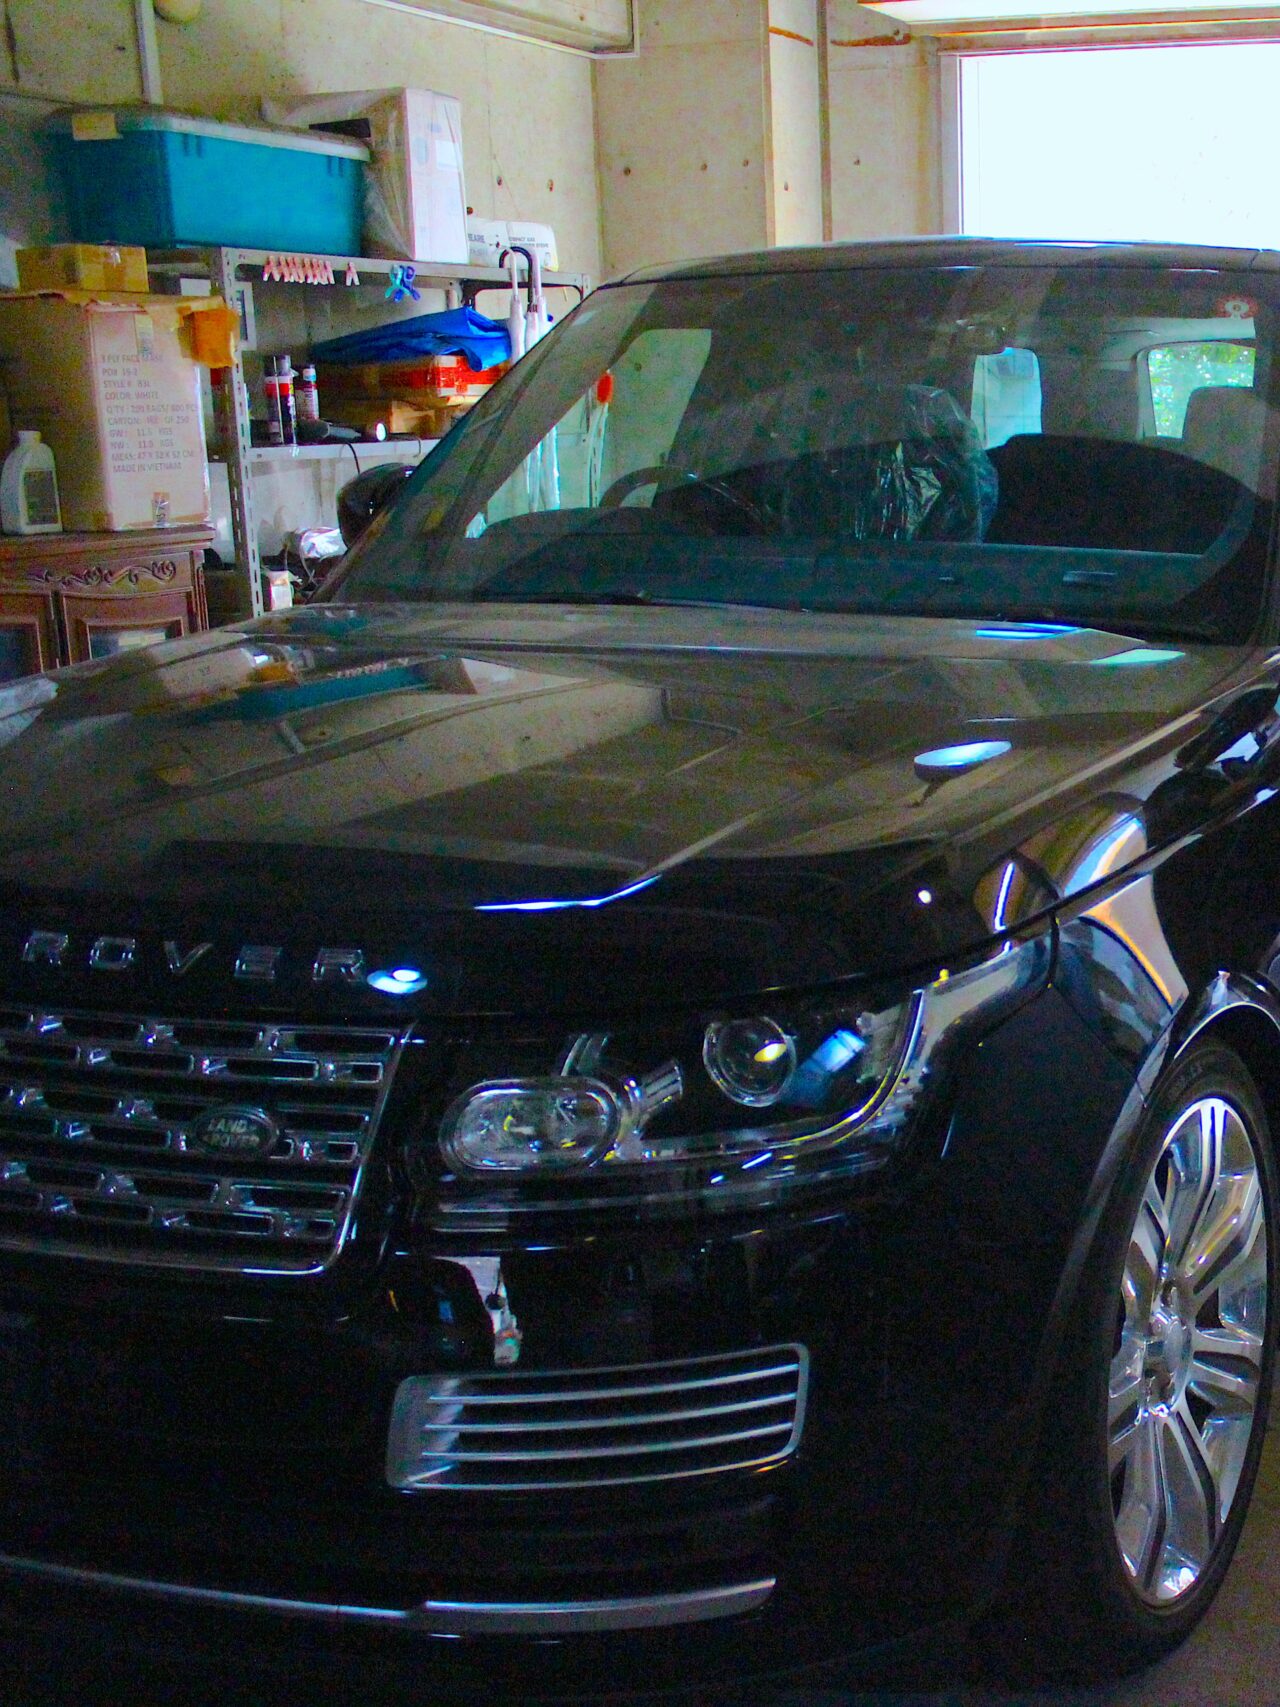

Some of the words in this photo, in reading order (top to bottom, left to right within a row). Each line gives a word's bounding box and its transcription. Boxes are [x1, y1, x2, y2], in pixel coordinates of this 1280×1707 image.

[135, 391, 158, 399] WHITE
[113, 463, 136, 472] MADE
[147, 462, 182, 471] VIETNAM
[22, 930, 366, 982] ROVER
[208, 1119, 249, 1133] LAND
